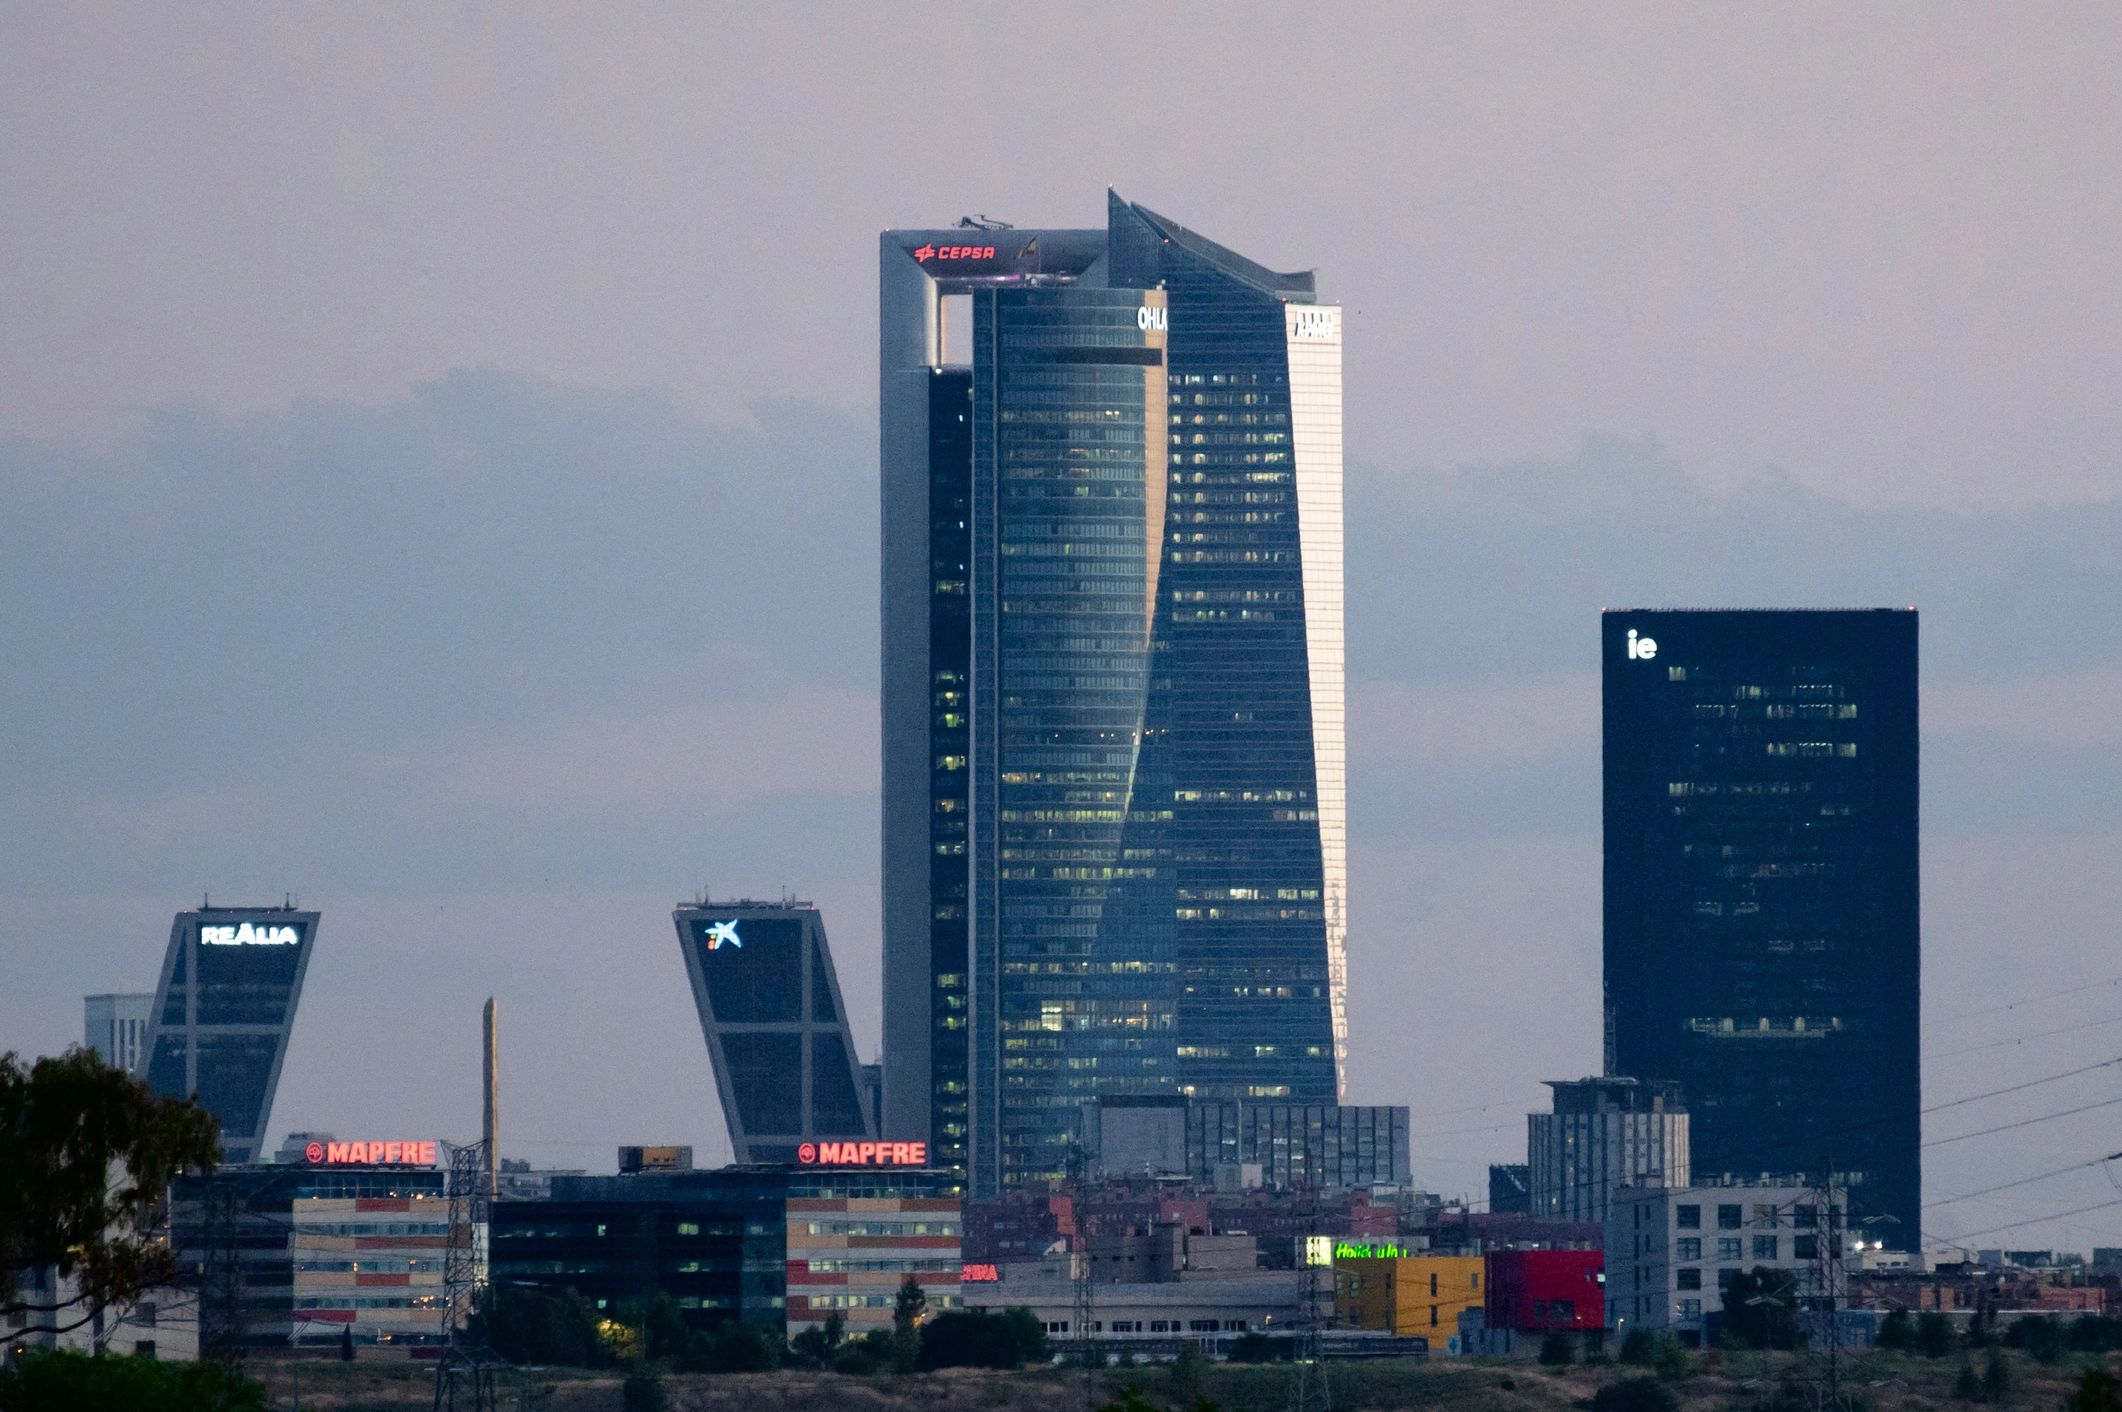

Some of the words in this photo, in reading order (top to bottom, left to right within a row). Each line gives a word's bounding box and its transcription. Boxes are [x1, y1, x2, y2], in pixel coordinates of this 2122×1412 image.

[938, 246, 995, 259] CEPSA
[1627, 628, 1658, 660] ie
[201, 922, 298, 946] REALIA
[327, 1141, 437, 1164] MAPFRE
[819, 1142, 926, 1165] MAPFRE
